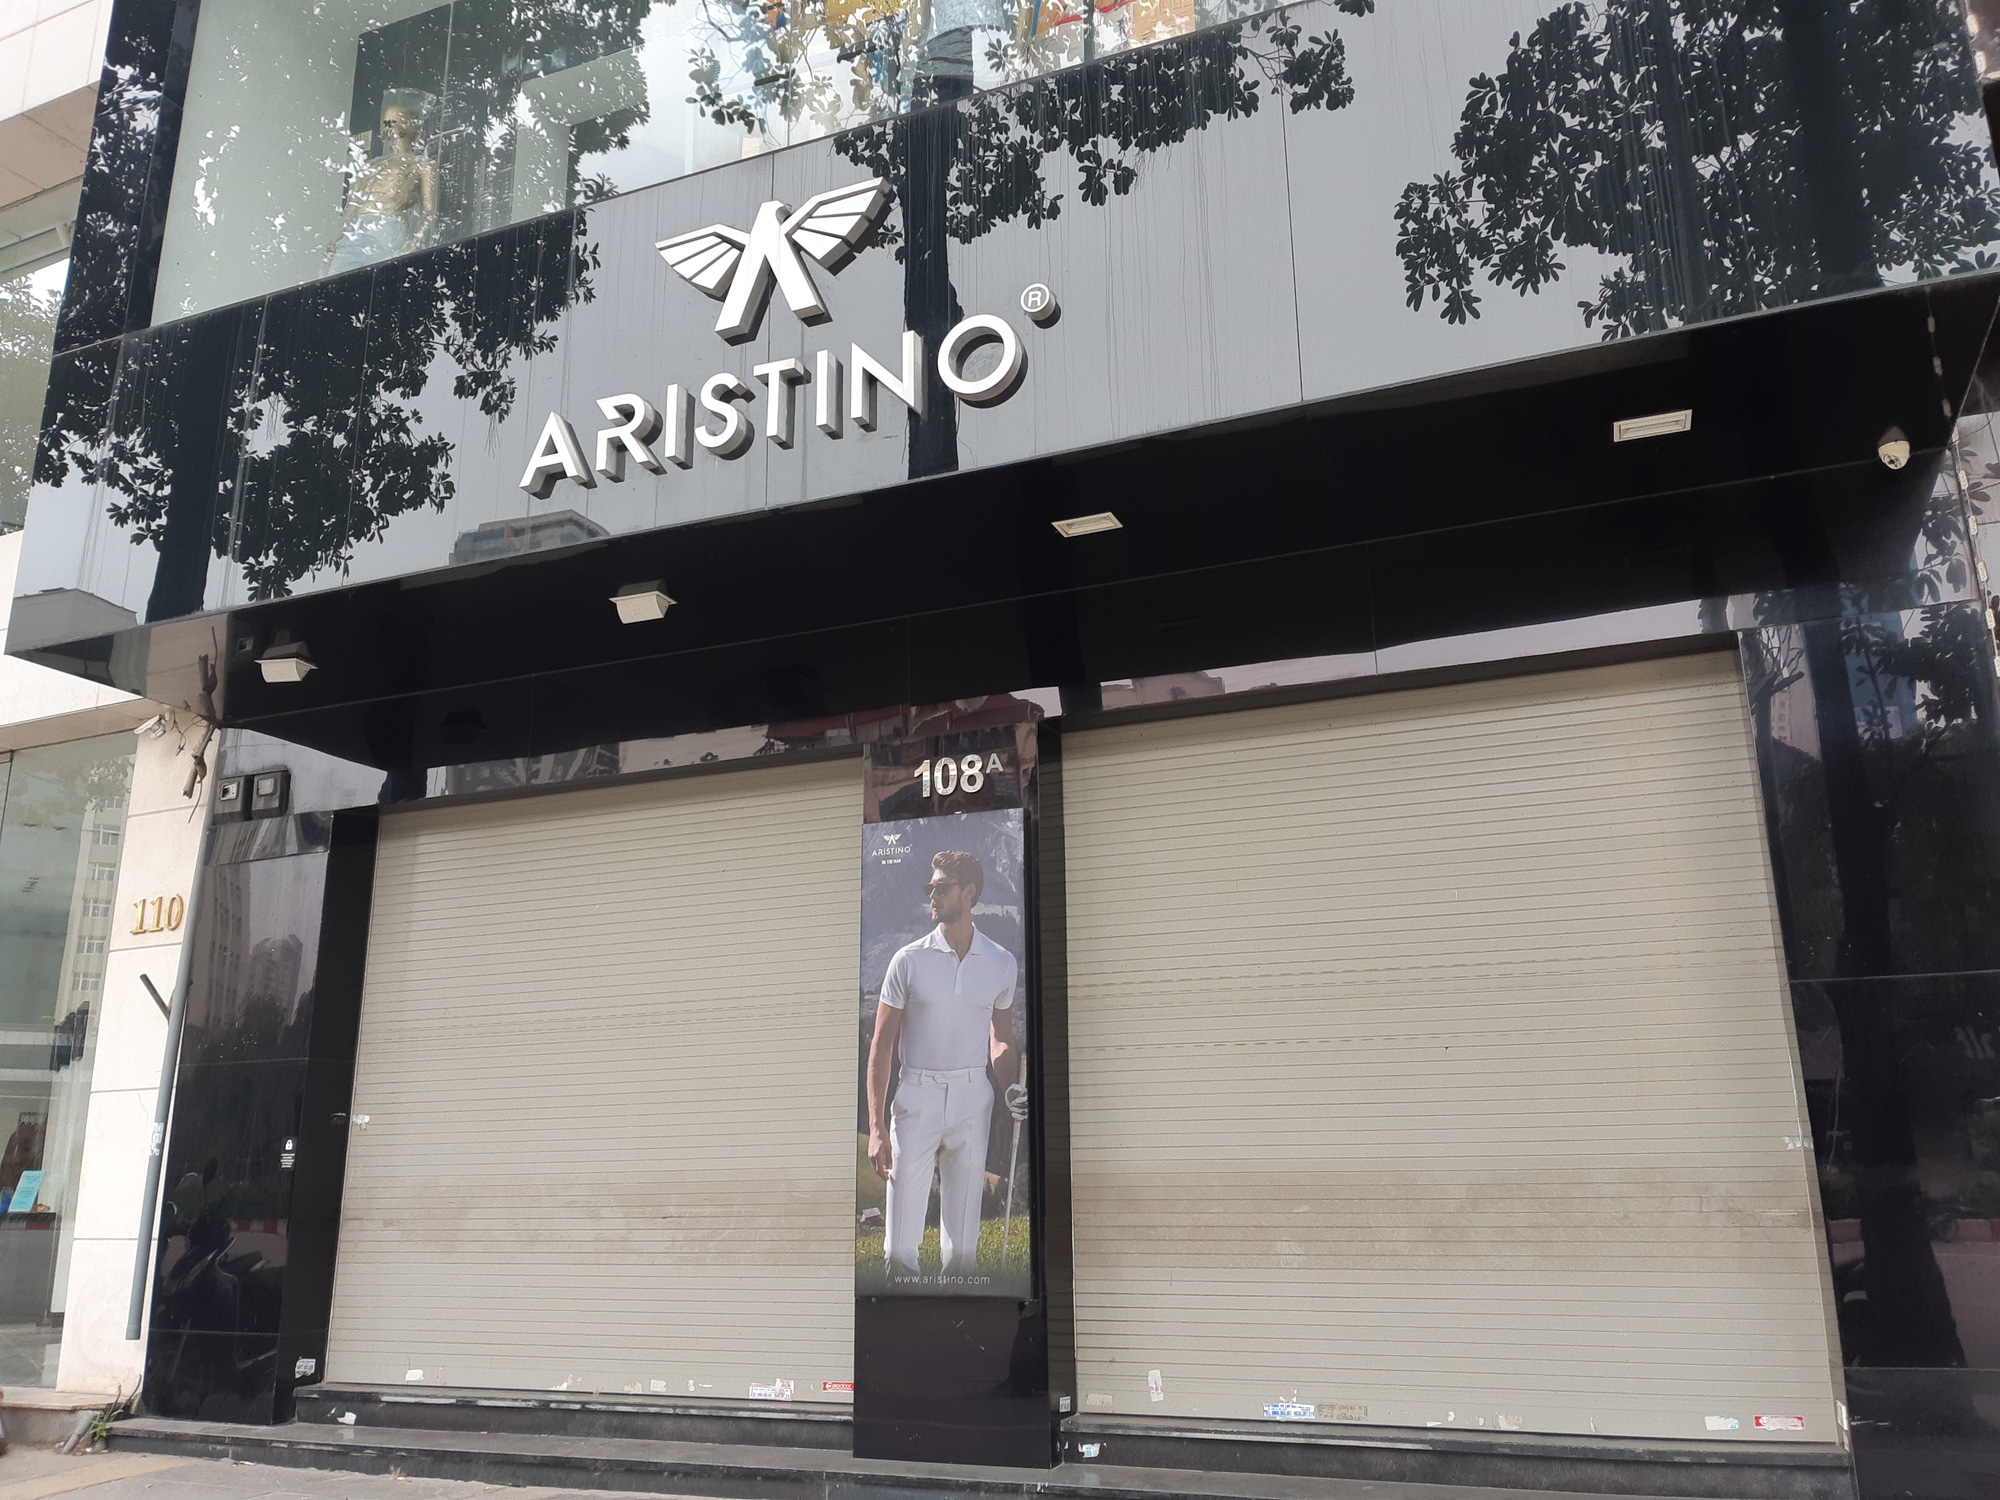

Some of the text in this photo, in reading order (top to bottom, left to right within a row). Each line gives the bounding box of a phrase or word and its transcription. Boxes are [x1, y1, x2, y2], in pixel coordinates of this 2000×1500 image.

[519, 314, 1026, 498] ARISTINO
[871, 845, 911, 857] ARISTINO
[129, 894, 184, 935] 110
[894, 1274, 990, 1285] www.aristino.com
